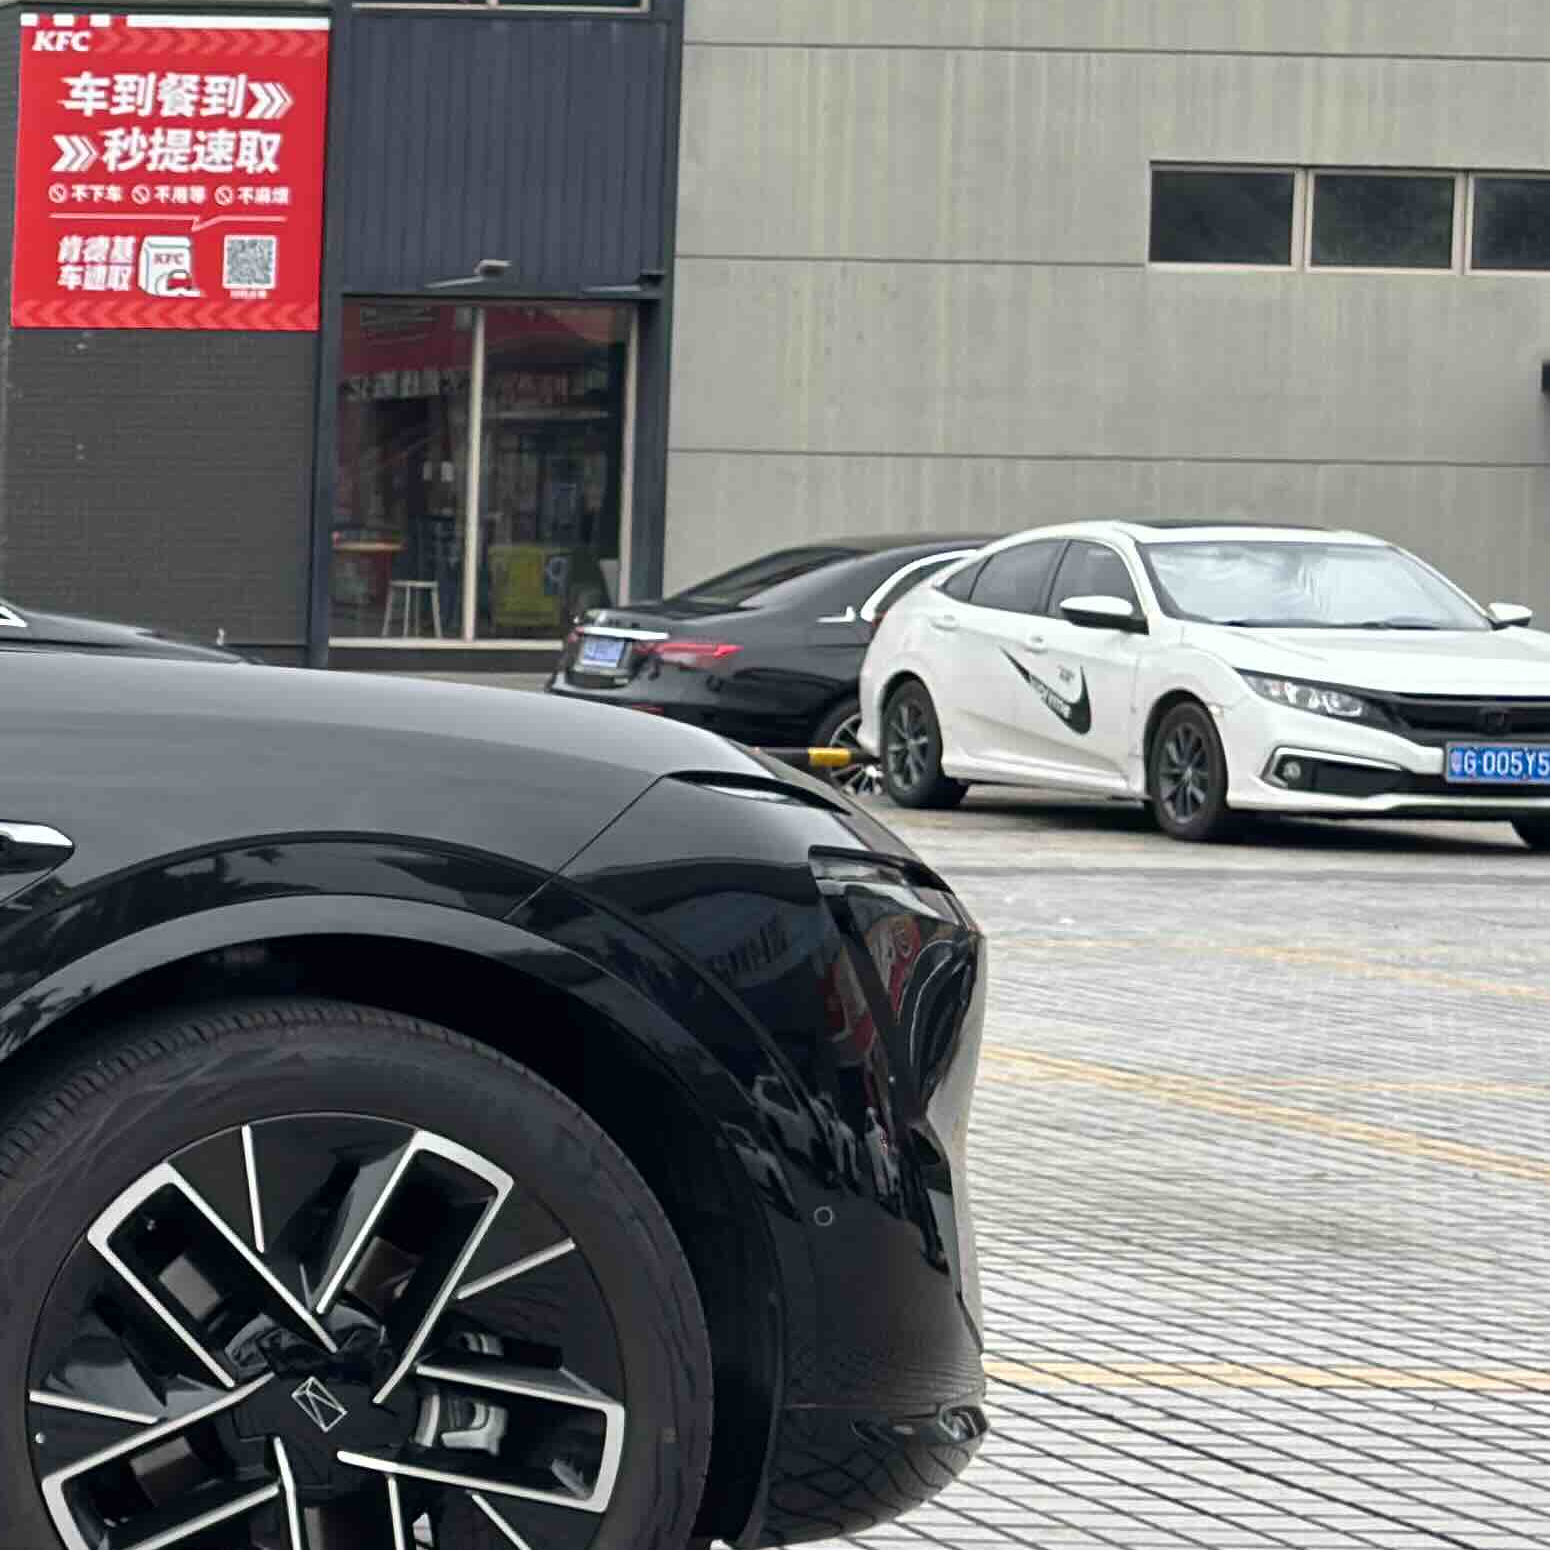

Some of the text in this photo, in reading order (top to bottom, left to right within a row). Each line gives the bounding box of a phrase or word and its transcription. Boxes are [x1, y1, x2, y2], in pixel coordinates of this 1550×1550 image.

[32, 30, 92, 52] KFC
[56, 70, 248, 119] 车到餐到
[101, 126, 283, 174] 秒提速取
[70, 184, 123, 202] 不下车
[152, 252, 186, 265] KFC
